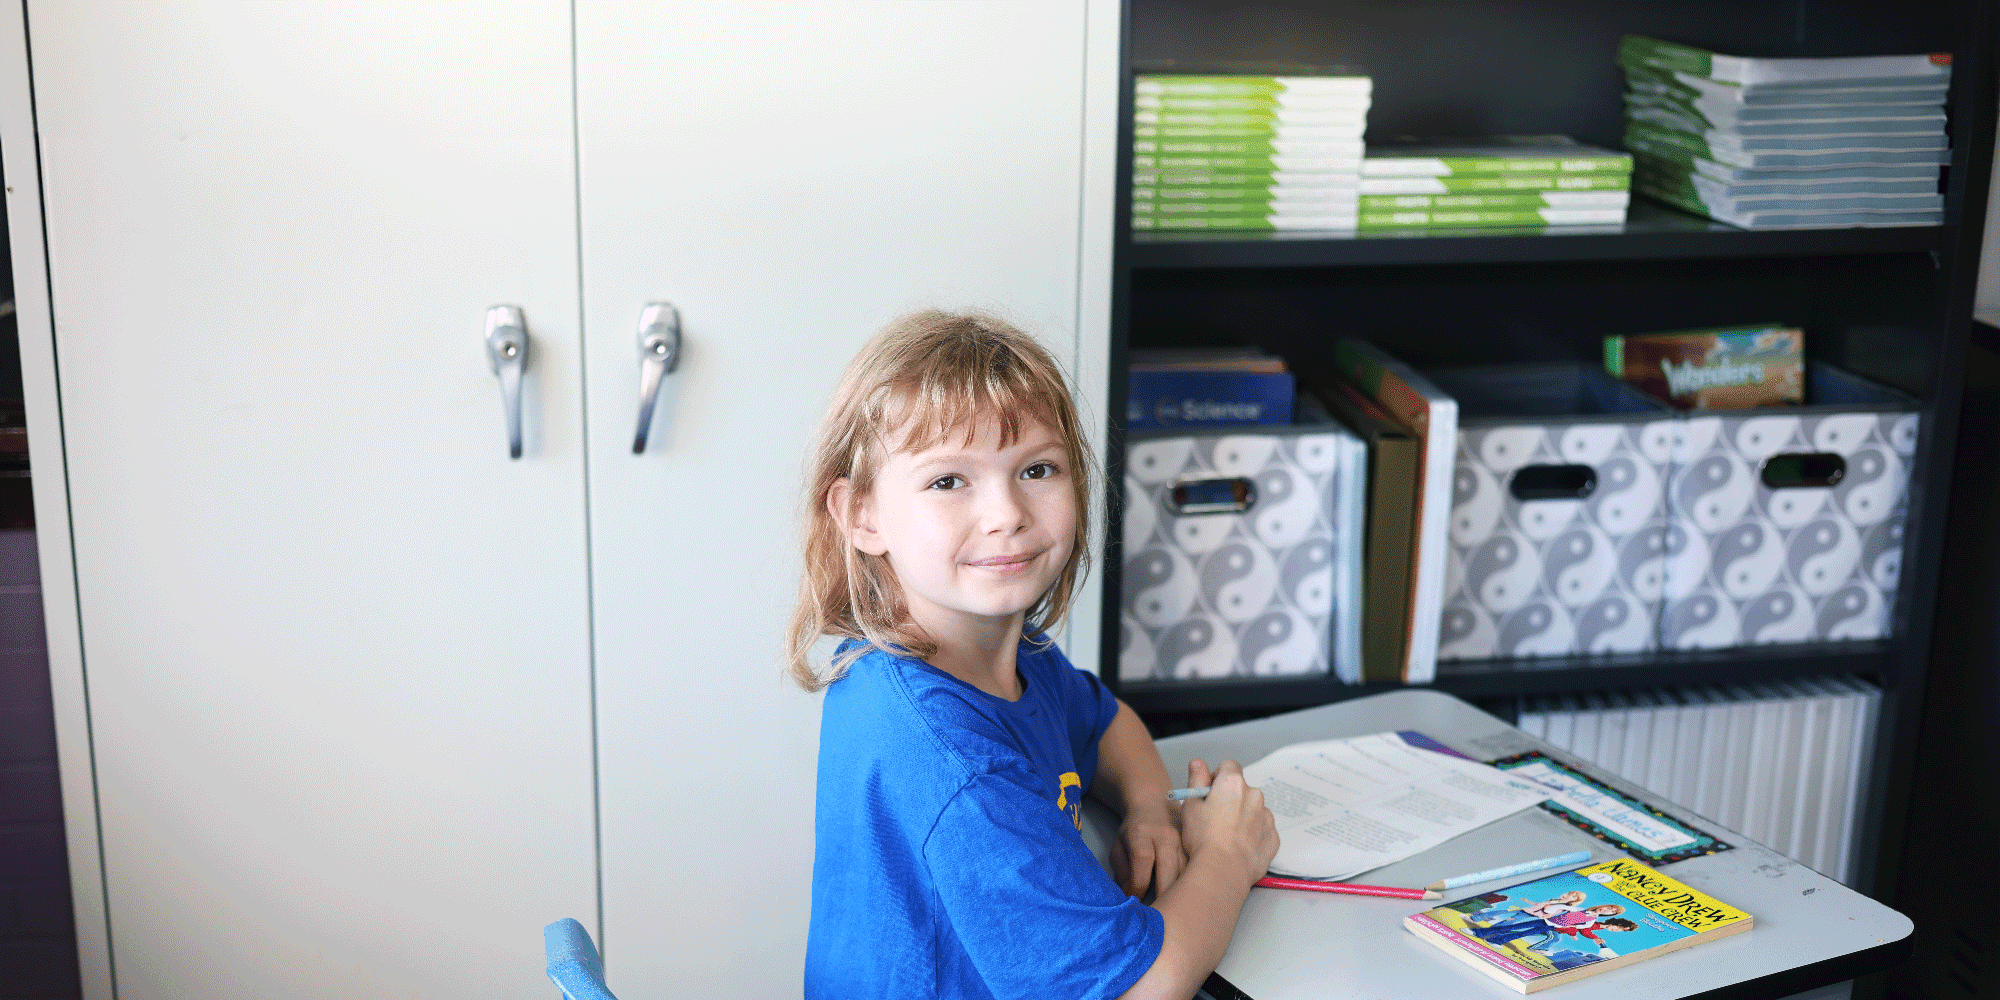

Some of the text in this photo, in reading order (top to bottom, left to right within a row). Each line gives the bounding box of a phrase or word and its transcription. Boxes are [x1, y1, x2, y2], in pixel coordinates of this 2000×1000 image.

[1660, 356, 1764, 397] Wonders
[1183, 399, 1261, 420] Science
[1626, 891, 1712, 929] CLUE CREW
[1662, 893, 1740, 923] DREW
